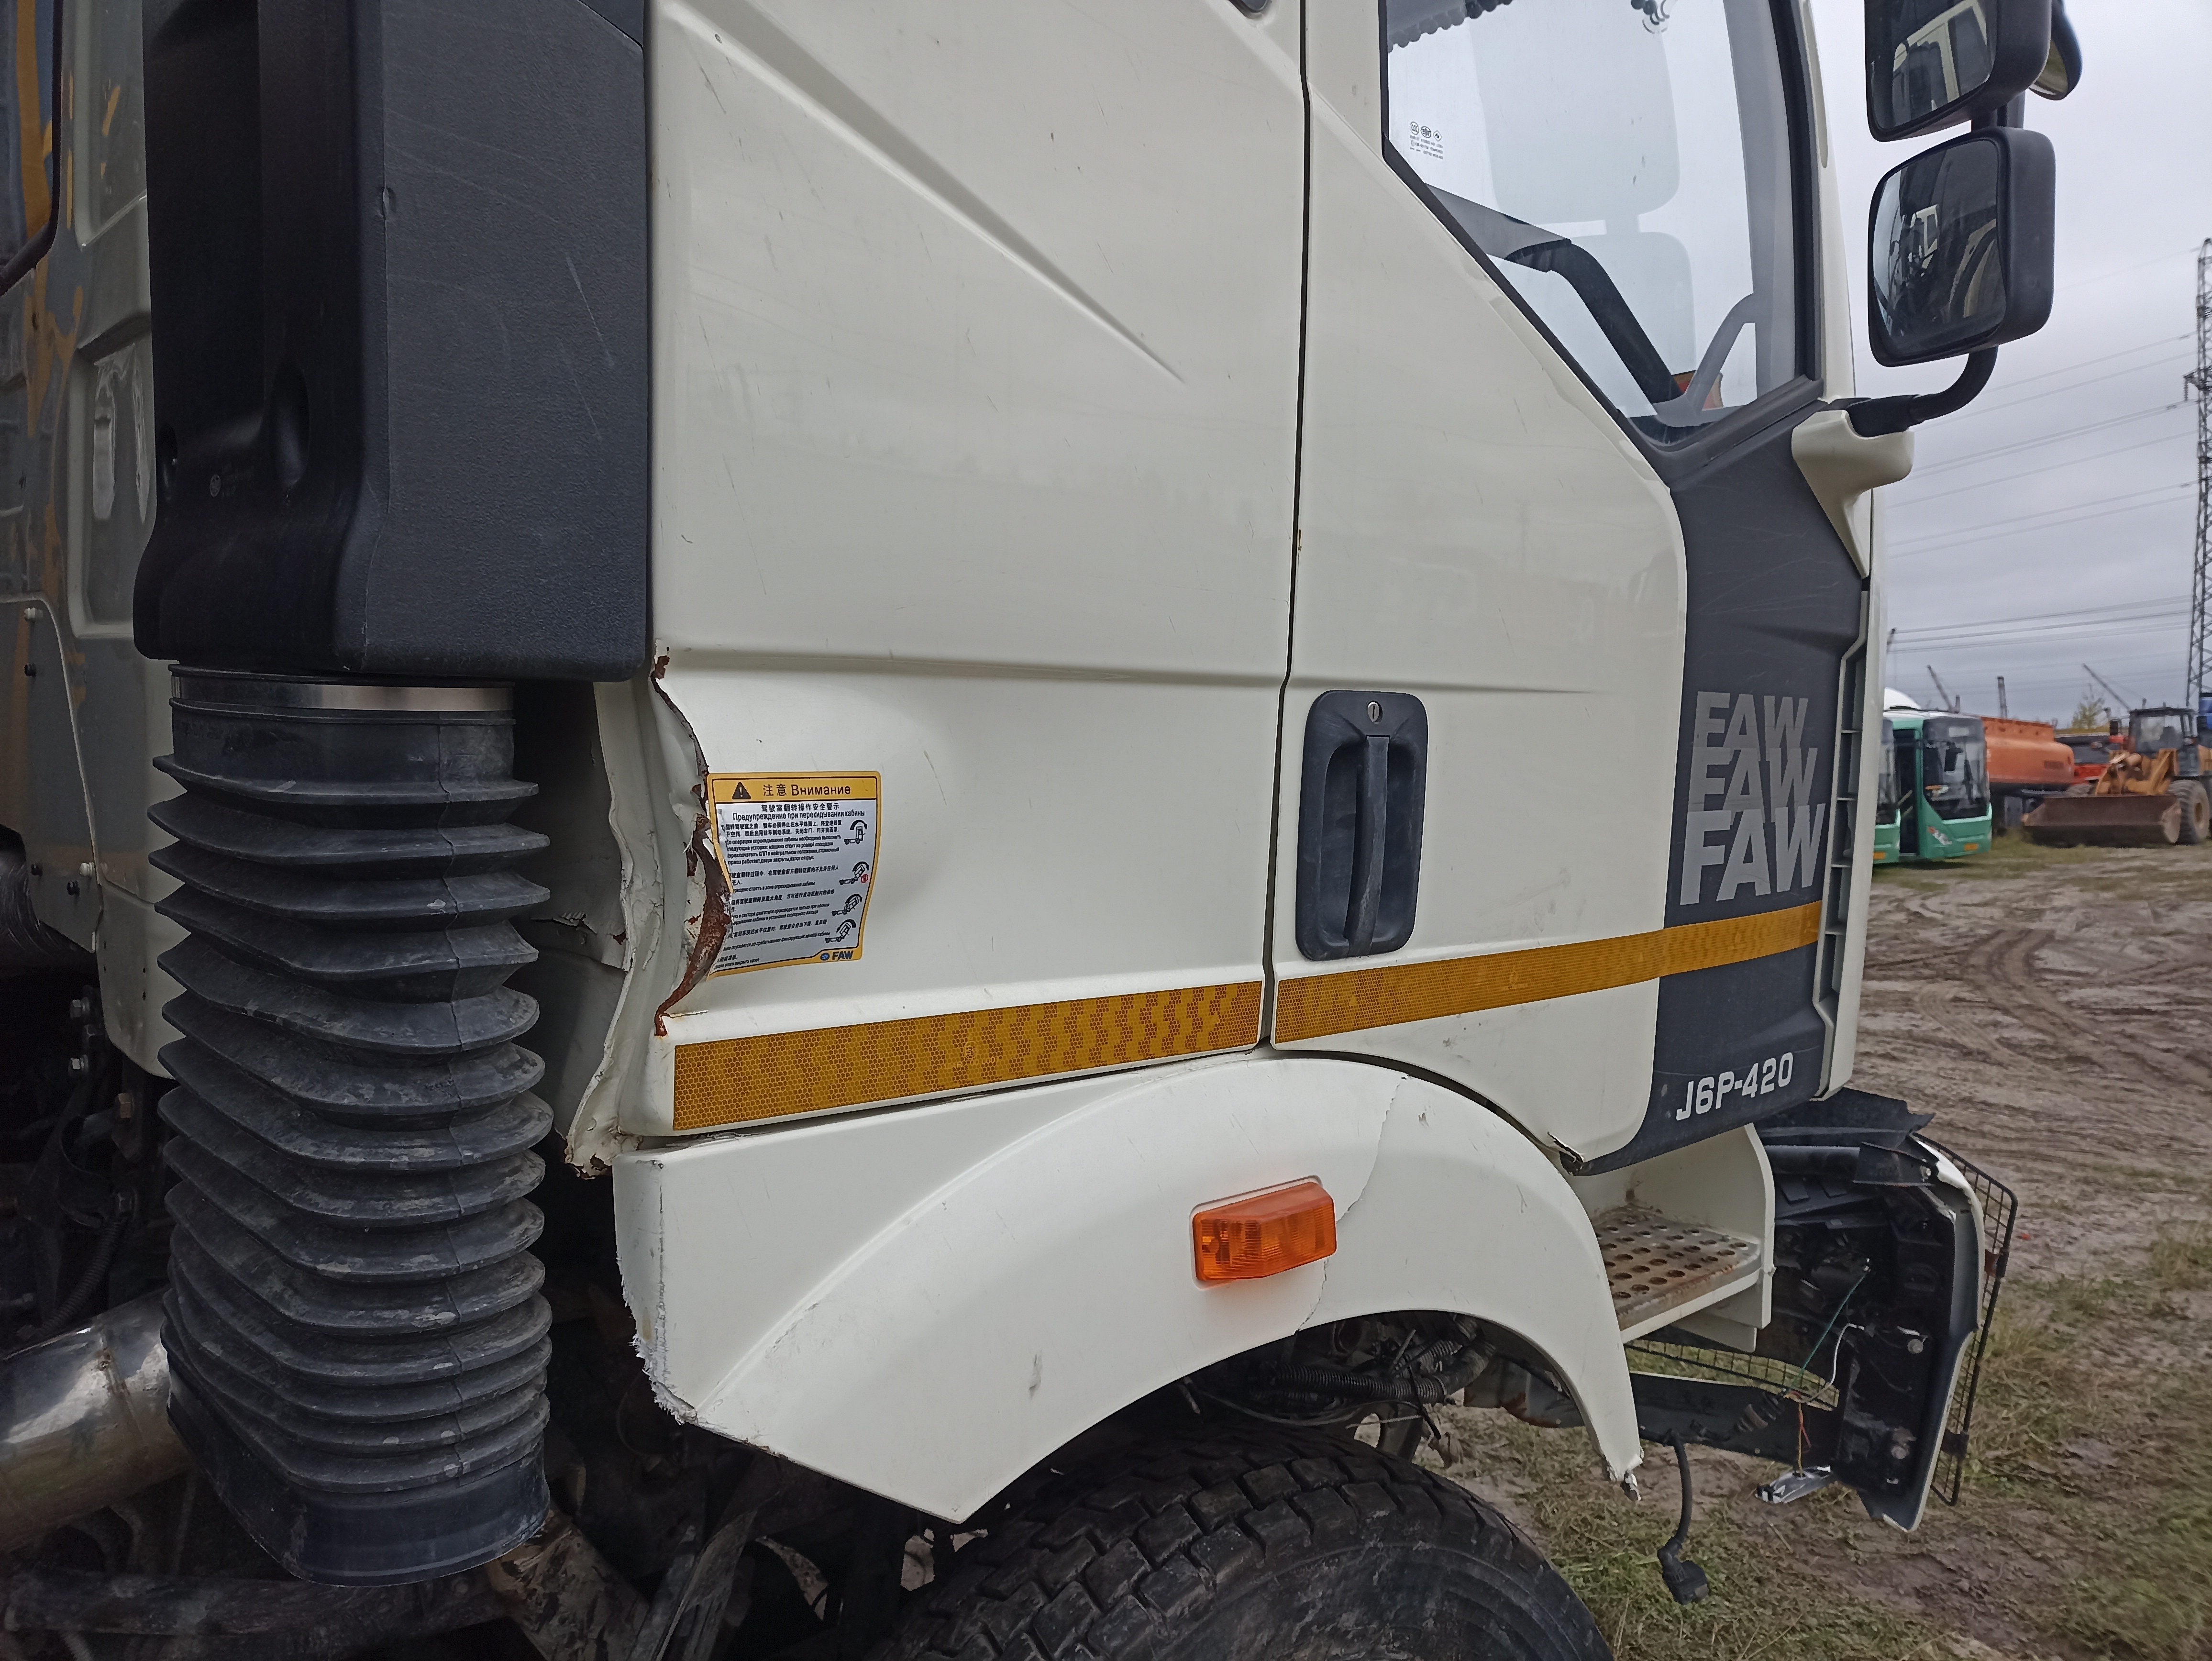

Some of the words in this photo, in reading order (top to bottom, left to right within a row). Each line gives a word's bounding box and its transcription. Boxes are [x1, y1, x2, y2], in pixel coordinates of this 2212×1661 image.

[791, 784, 851, 796] Внимание
[1687, 747, 1818, 823] FAW
[733, 813, 786, 822] Предупреждение
[1680, 803, 1825, 905] FAW
[832, 950, 854, 961] FAW
[1676, 1052, 1793, 1121] J6P-420
